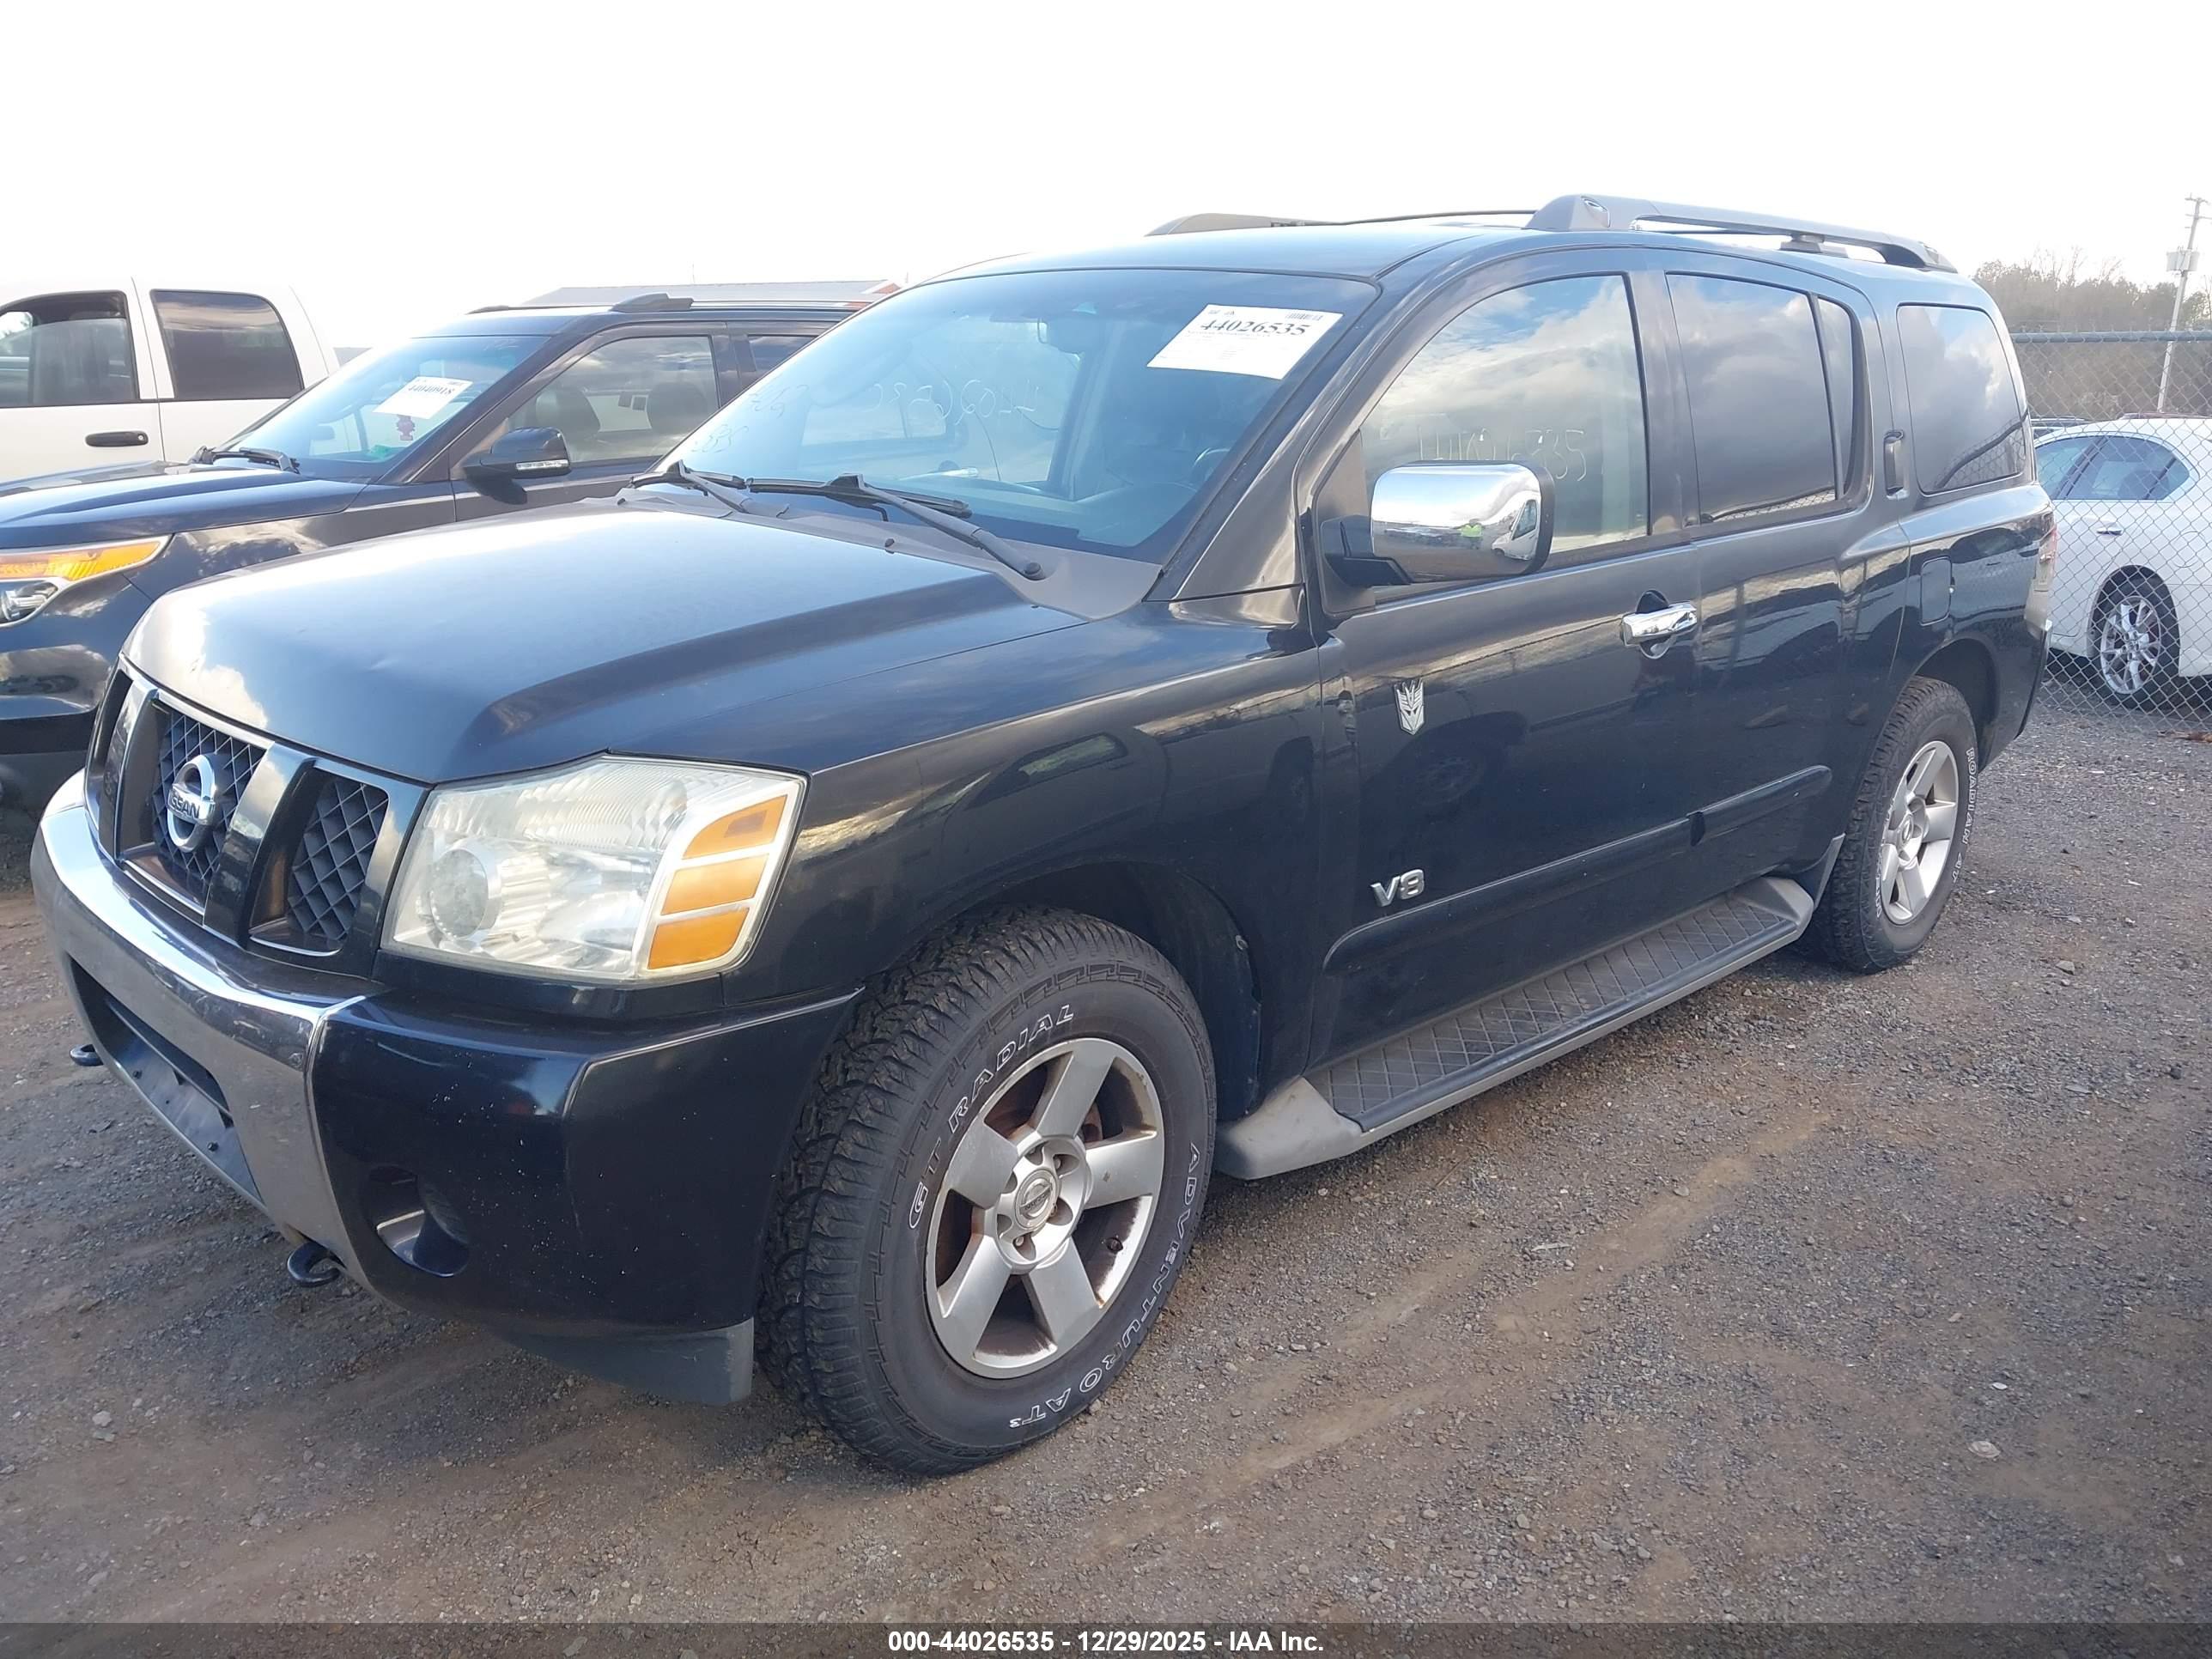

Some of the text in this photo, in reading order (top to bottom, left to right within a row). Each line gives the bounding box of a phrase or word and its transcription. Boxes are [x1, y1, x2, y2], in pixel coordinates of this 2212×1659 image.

[1200, 319, 1313, 337] 44026535
[1962, 746, 1977, 846] ROADIAN
[1370, 868, 1425, 908] V8
[908, 1004, 1074, 1229] GT RADIAL
[1079, 1142, 1200, 1394] ADVENTURO
